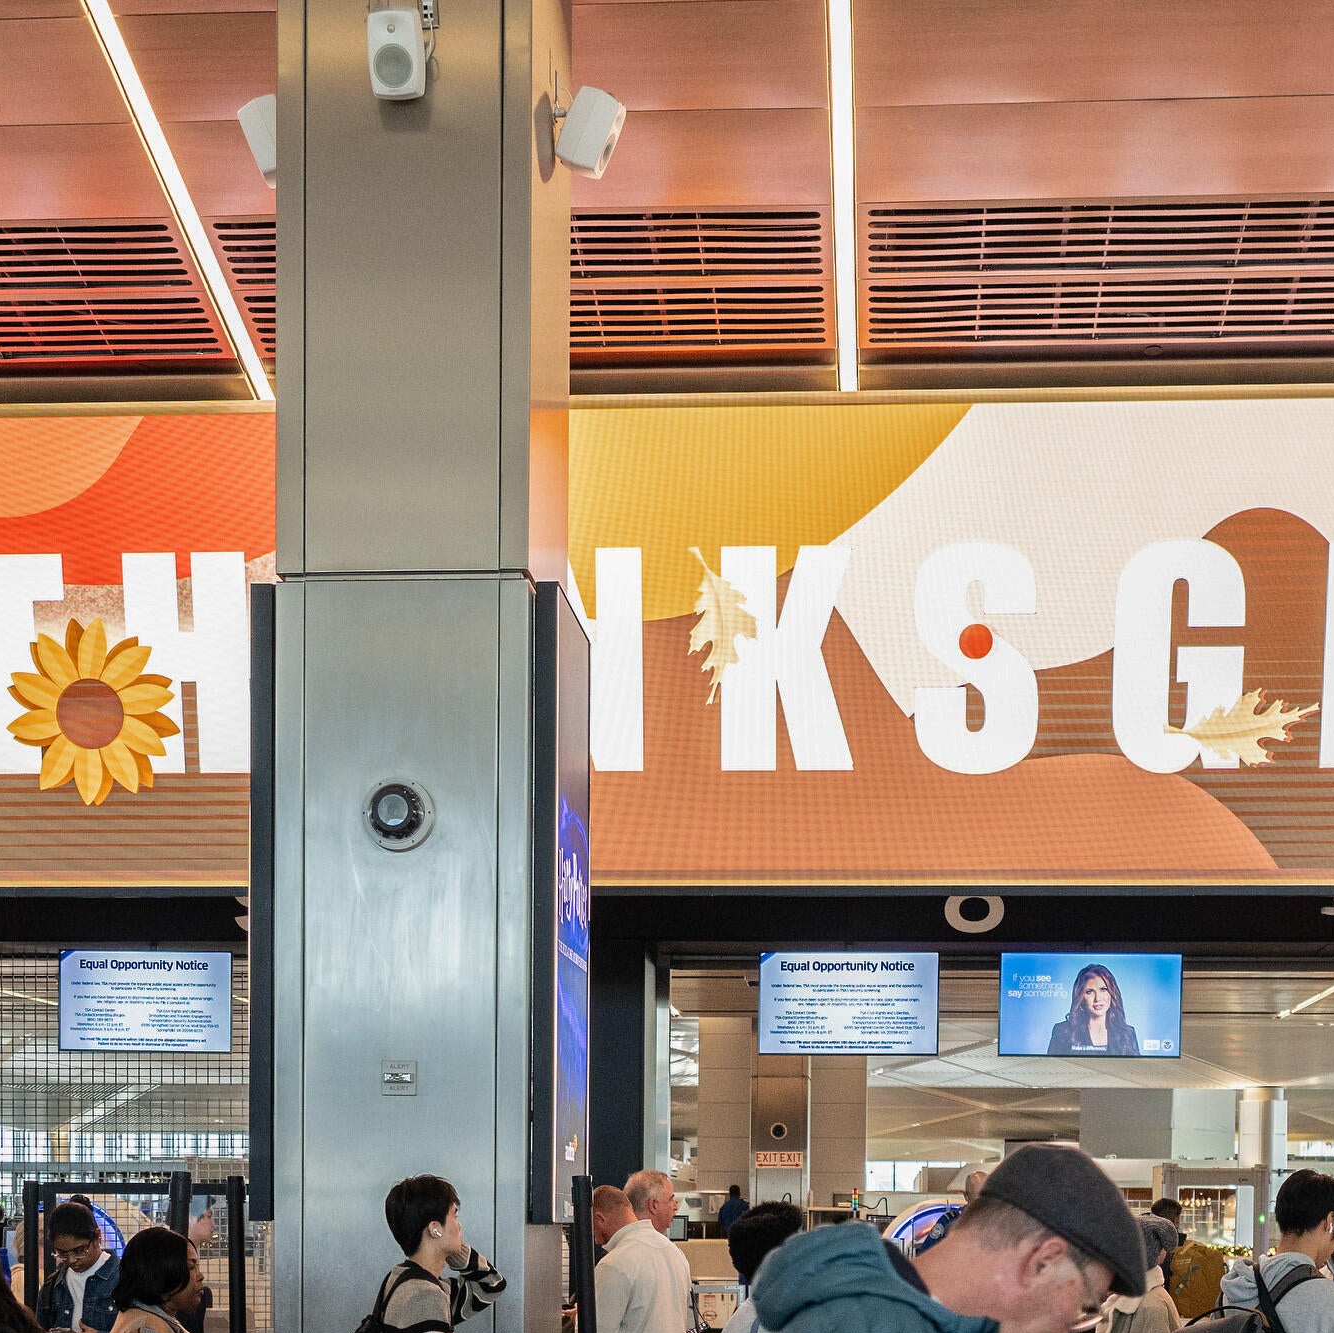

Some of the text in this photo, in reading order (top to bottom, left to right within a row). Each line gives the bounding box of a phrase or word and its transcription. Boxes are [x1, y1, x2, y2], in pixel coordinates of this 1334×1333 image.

[79, 959, 209, 972] Equal Opportunity Notice
[780, 960, 914, 973] Equal Opportunity Notice
[1036, 974, 1051, 982] see
[1008, 989, 1067, 998] say something
[756, 1153, 777, 1162] EXIT
[780, 1153, 801, 1162] EXIT
